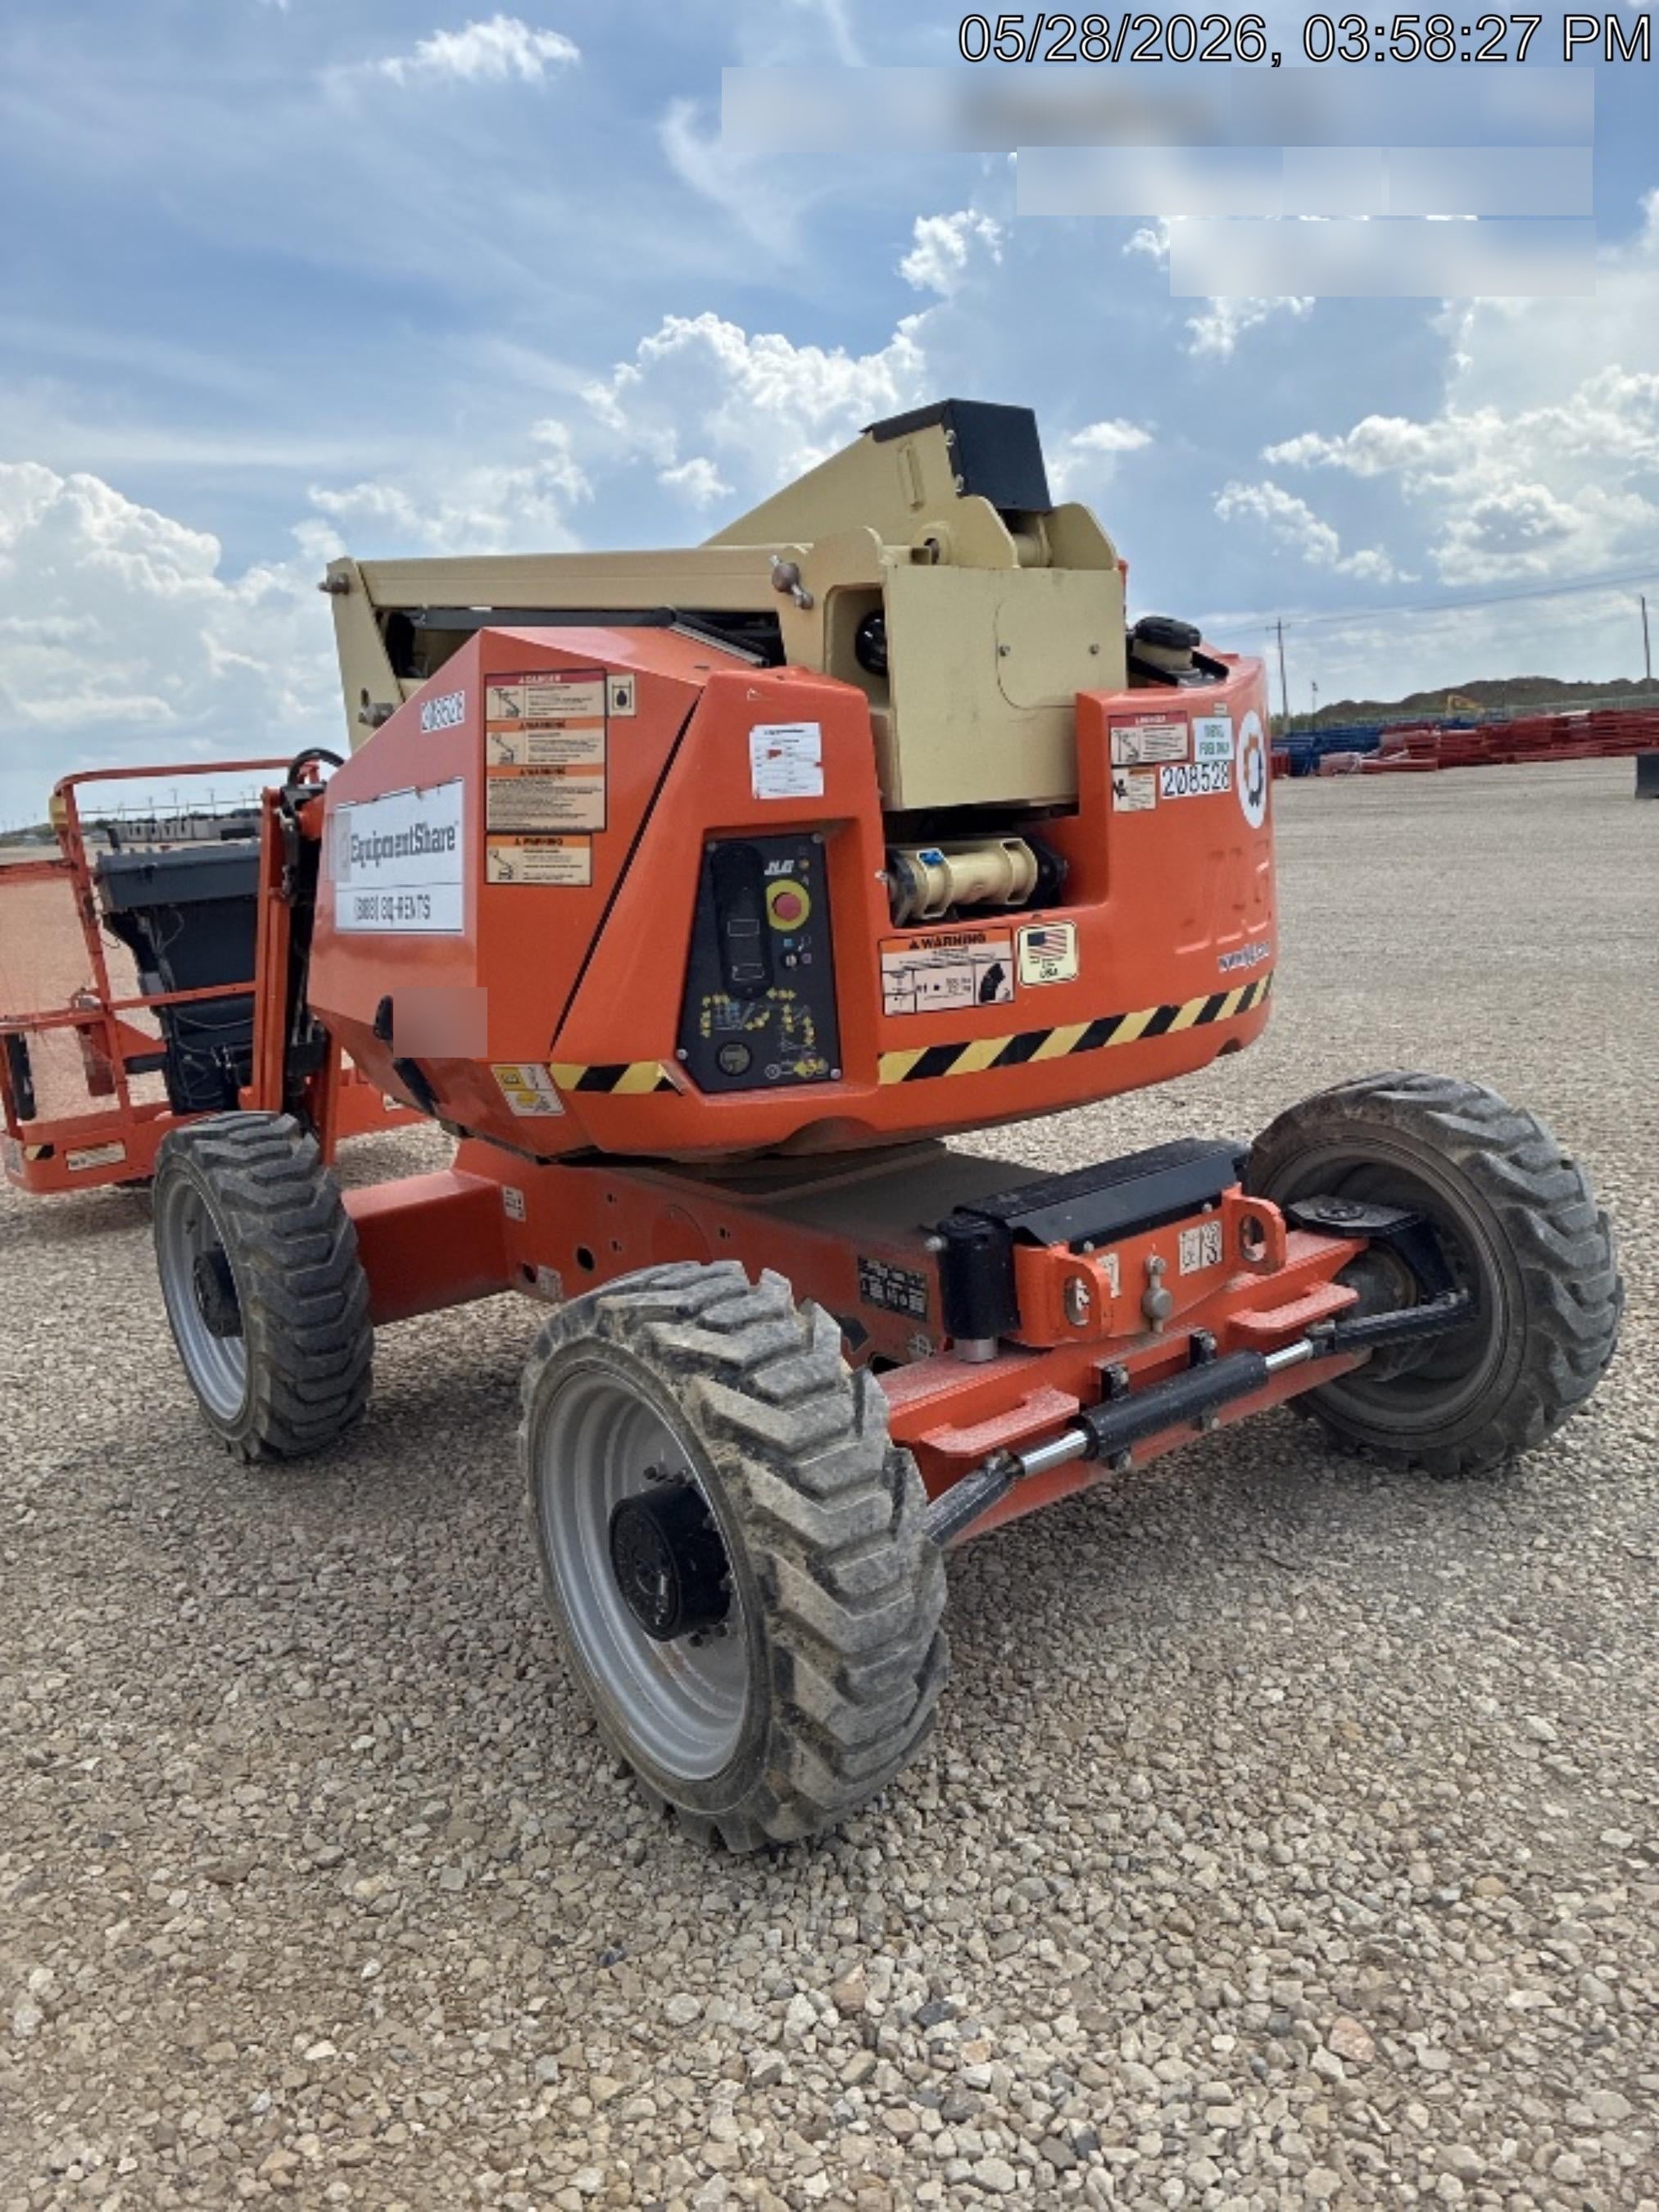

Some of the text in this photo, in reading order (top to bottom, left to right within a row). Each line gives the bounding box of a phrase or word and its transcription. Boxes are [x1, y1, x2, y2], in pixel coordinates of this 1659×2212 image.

[1162, 762, 1230, 796] 208528
[351, 822, 456, 868] EquipmentShare
[921, 933, 986, 949] WARNING
